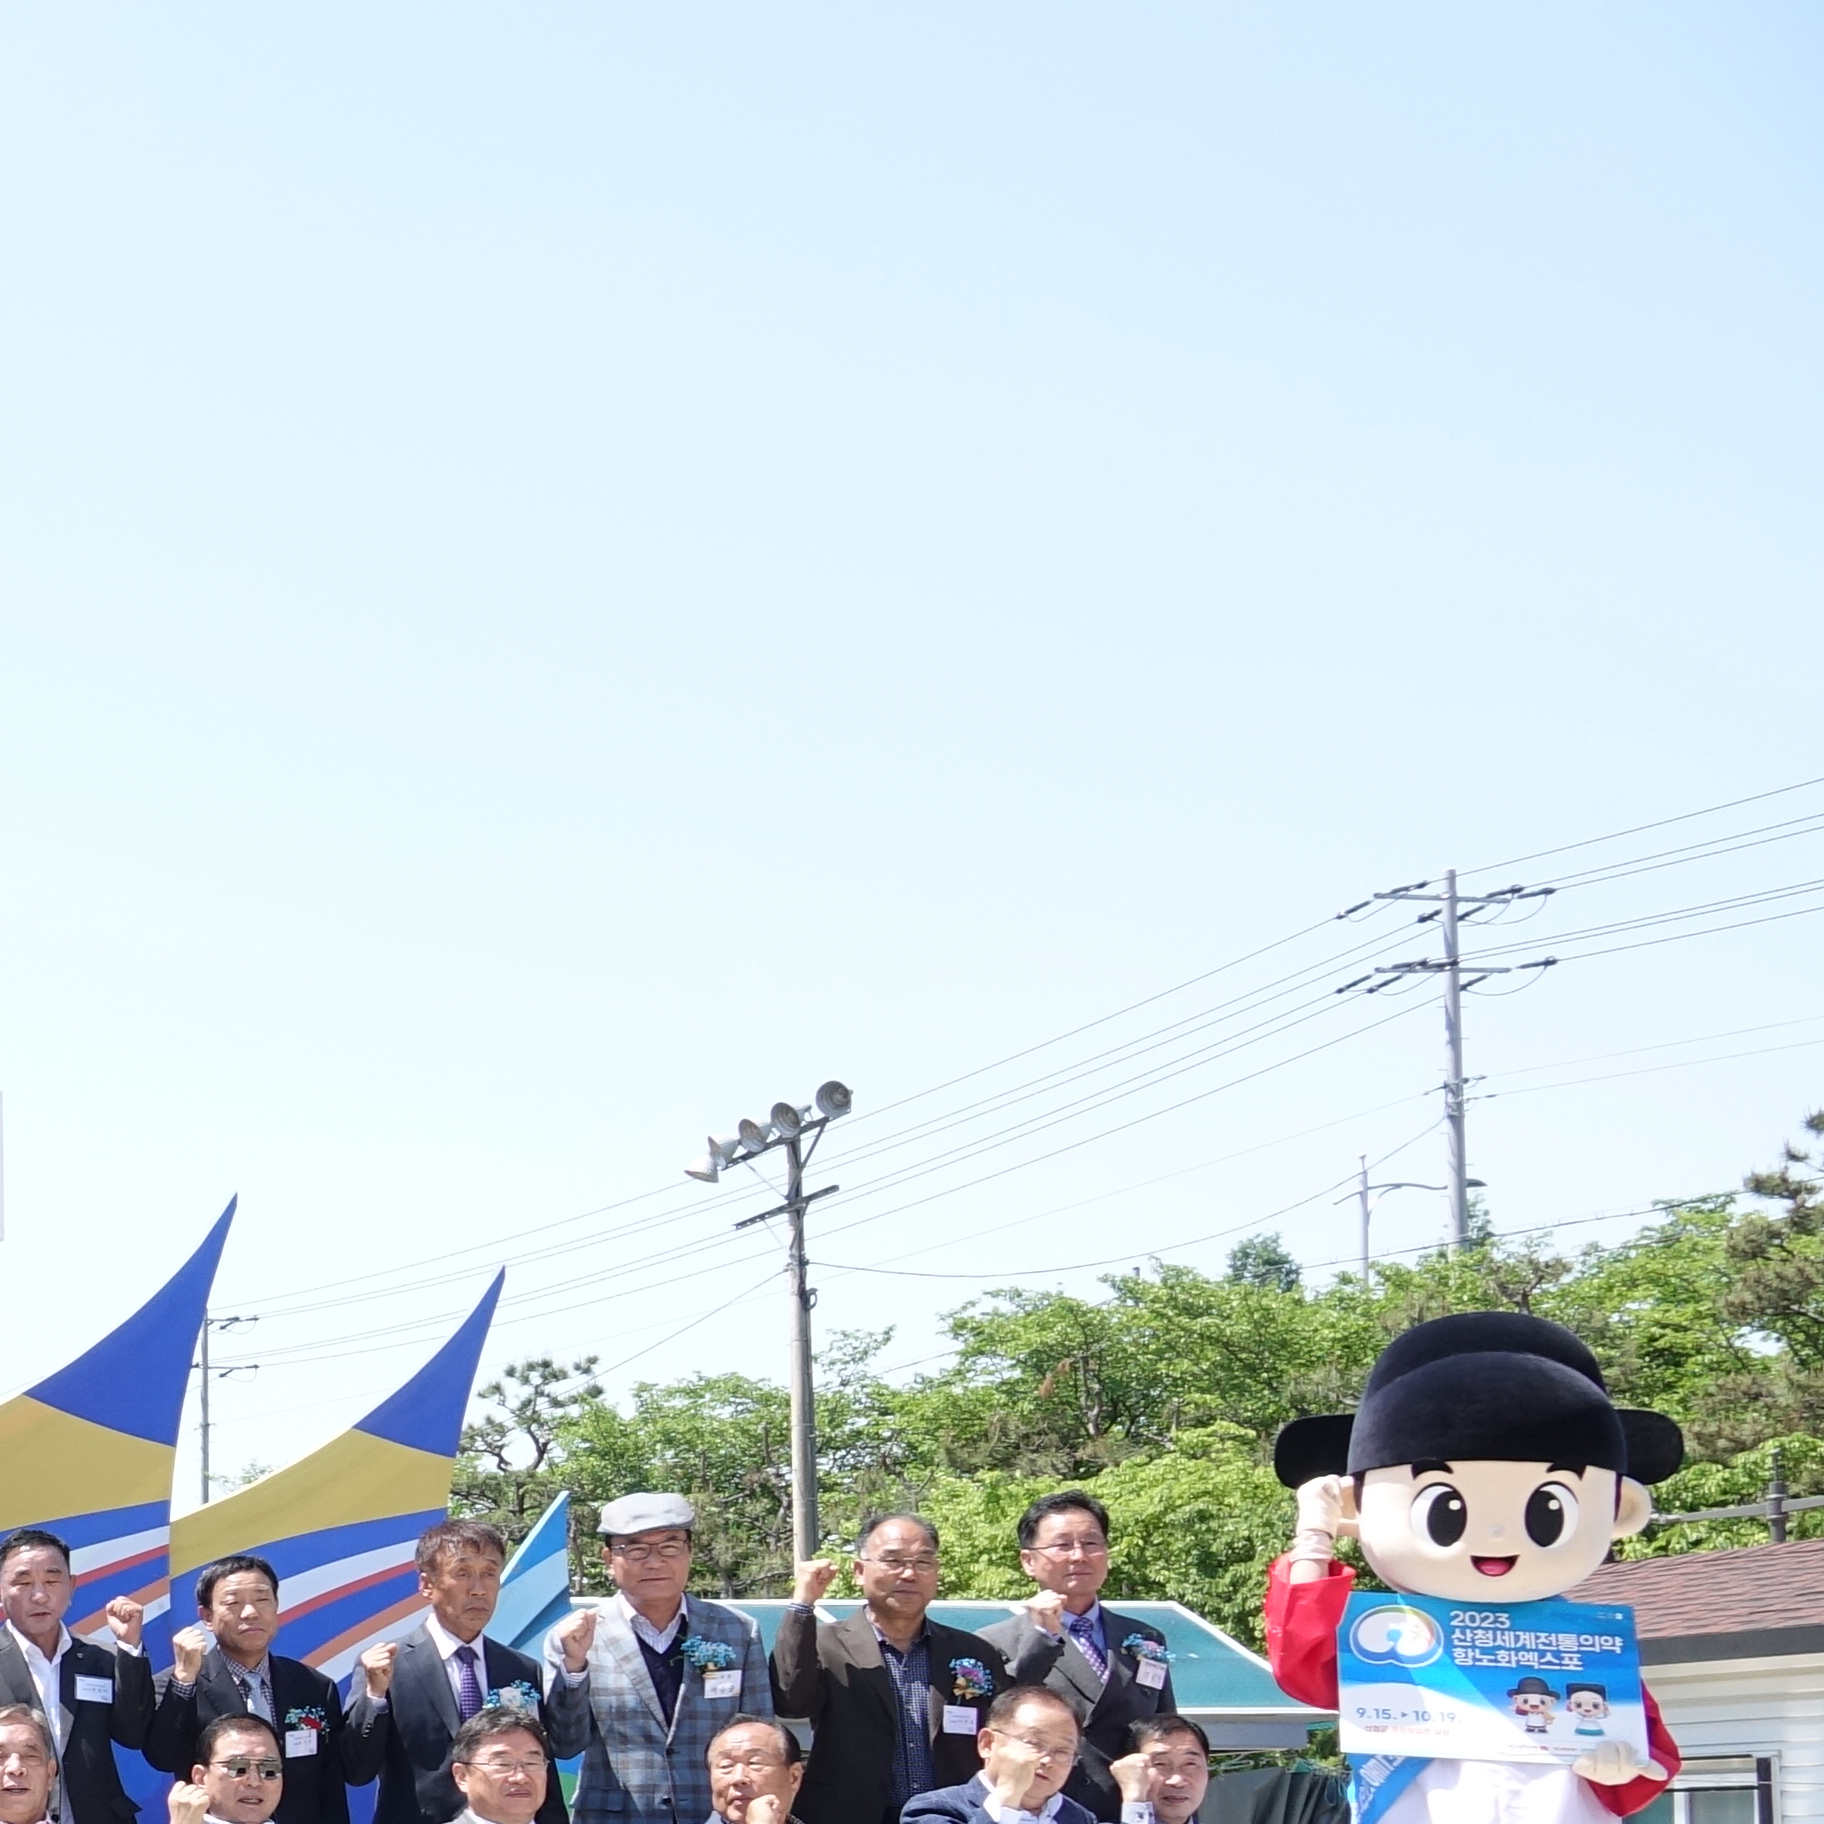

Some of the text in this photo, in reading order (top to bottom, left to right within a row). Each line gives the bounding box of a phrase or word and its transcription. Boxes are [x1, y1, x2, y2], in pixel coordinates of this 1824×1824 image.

[1450, 1611, 1510, 1628] 2023
[1452, 1630, 1623, 1652] 산청세계전통의약
[1453, 1649, 1583, 1670] 항노화엑스포
